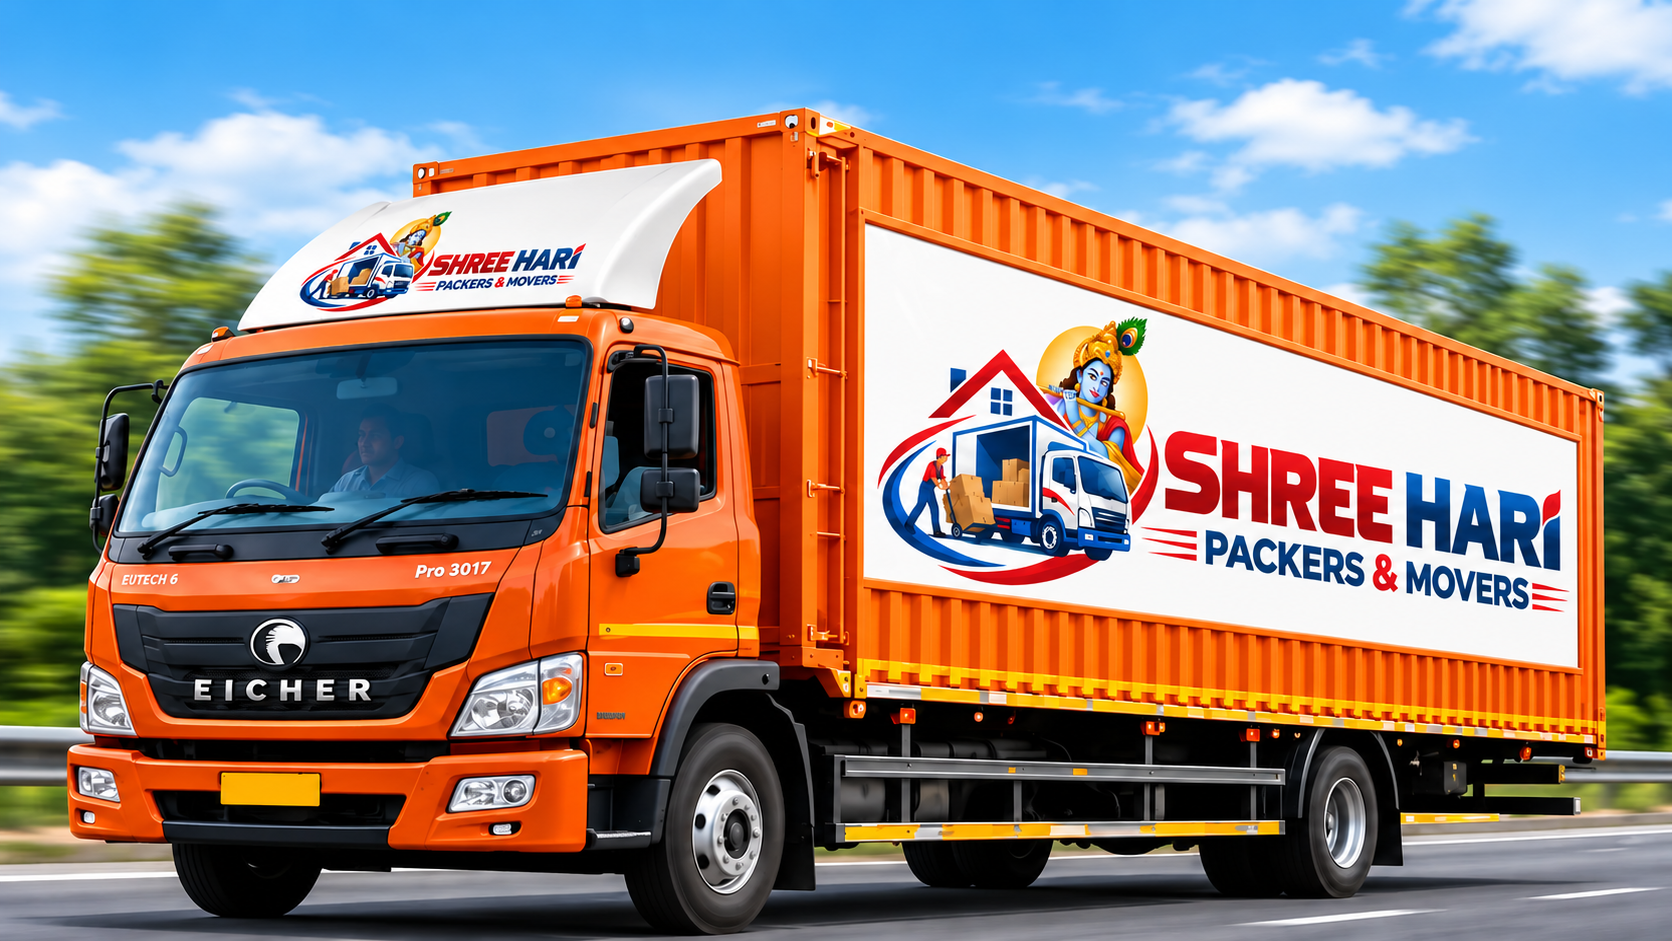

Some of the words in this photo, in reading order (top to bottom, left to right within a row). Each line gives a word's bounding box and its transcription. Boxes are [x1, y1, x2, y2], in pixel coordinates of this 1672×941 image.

[428, 251, 516, 277] SHREE
[435, 278, 493, 292] PACKERS
[494, 276, 505, 288] &
[507, 274, 558, 288] MOVERS
[1164, 430, 1393, 544] SHREE
[120, 573, 168, 587] EUTECH
[169, 573, 179, 586] 6
[414, 564, 445, 580] Pro
[448, 561, 492, 577] 3017
[1205, 529, 1365, 588] PACKERS
[1372, 553, 1399, 593] &
[1405, 560, 1530, 611] MOVERS
[193, 678, 373, 703] EICHER
